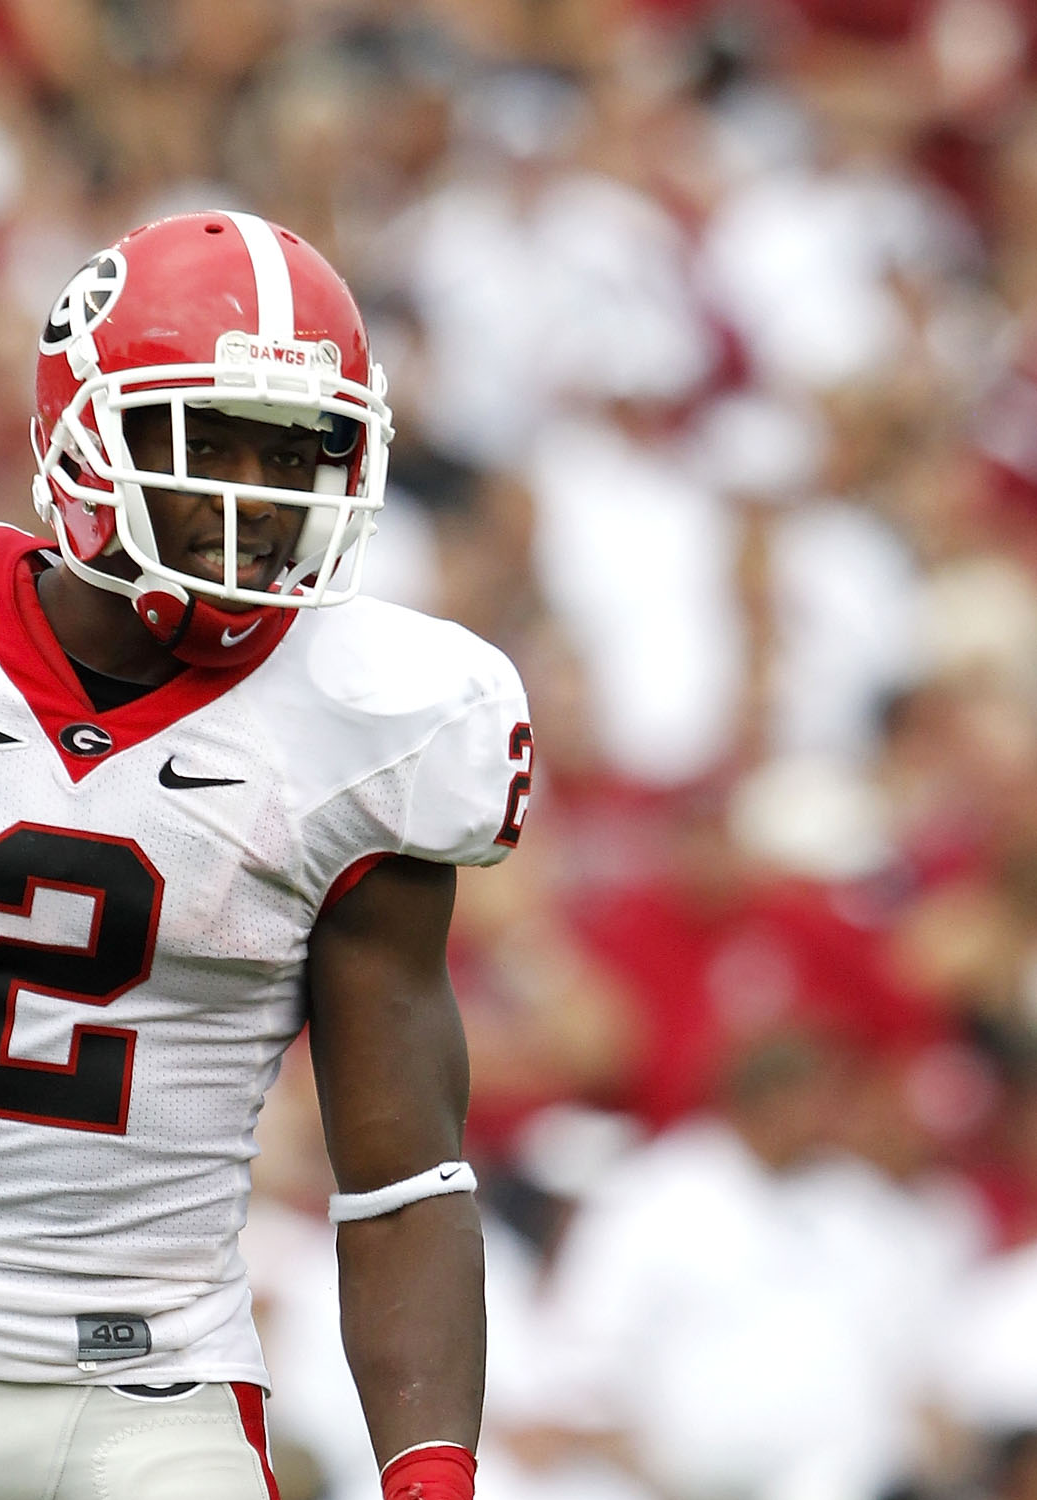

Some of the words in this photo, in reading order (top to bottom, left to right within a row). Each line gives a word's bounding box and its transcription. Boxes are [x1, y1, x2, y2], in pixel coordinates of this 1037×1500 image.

[250, 343, 305, 365] DAWGS
[65, 726, 112, 754] G
[91, 1324, 135, 1343] 40
